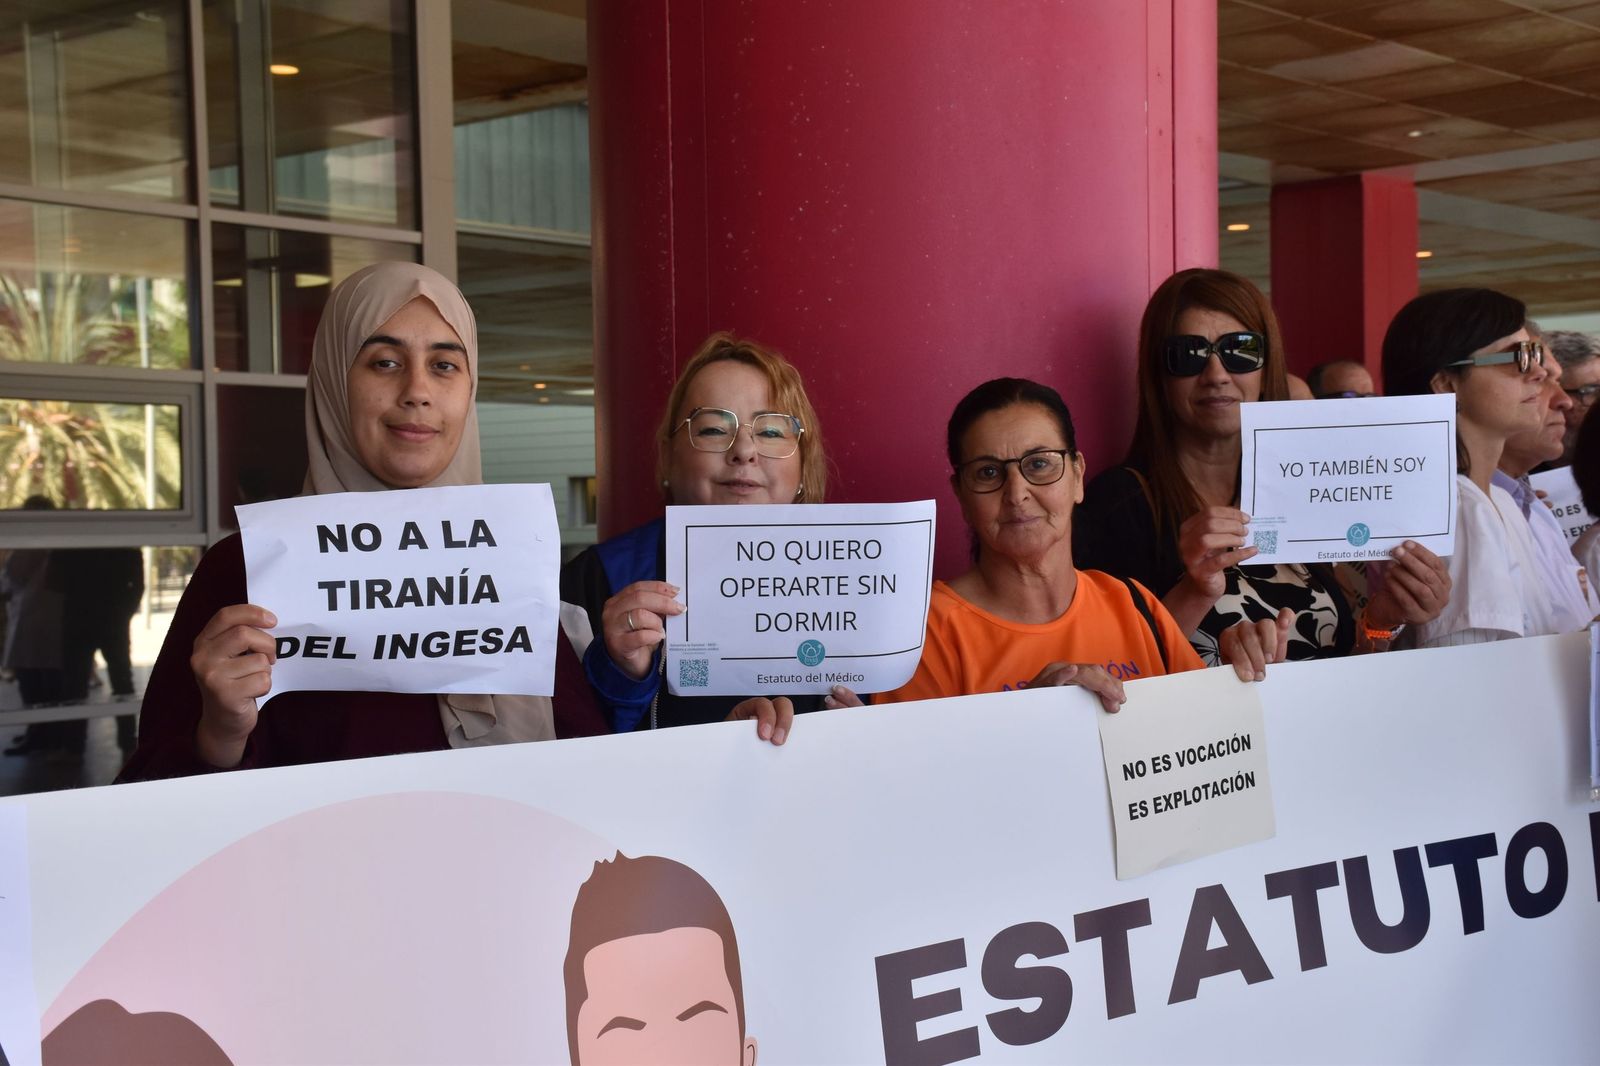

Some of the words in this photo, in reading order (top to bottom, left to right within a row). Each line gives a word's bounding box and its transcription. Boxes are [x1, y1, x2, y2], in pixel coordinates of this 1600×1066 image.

[1279, 462, 1304, 478] YO
[1309, 455, 1388, 477] TAMBIÉN
[1393, 456, 1427, 474] SOY
[1309, 485, 1393, 503] PACIENTE
[1566, 503, 1580, 515] ES
[316, 523, 382, 553] NO
[398, 521, 429, 550] A
[441, 519, 497, 548] LA
[736, 541, 776, 561] NO
[784, 539, 882, 565] QUIERO
[1317, 551, 1351, 562] Estatuto
[1353, 548, 1366, 559] del
[1368, 547, 1393, 558] Médic
[317, 568, 500, 611] TIRANÍA
[720, 576, 849, 597] OPERARTE
[857, 574, 897, 595] SIN
[755, 611, 857, 632] DORMIR
[276, 636, 356, 659] DEL
[373, 626, 533, 660] INGESA
[757, 674, 802, 684] Estatuto
[805, 673, 822, 683] del
[825, 672, 865, 683] Médico
[1122, 760, 1147, 781] NO
[1151, 754, 1172, 774] ES
[1175, 733, 1251, 767] VOCACIÓN
[1128, 800, 1149, 821] ES
[1153, 771, 1256, 814] EXPLOTACIÓN
[874, 821, 1569, 1066] ESTATUTO
